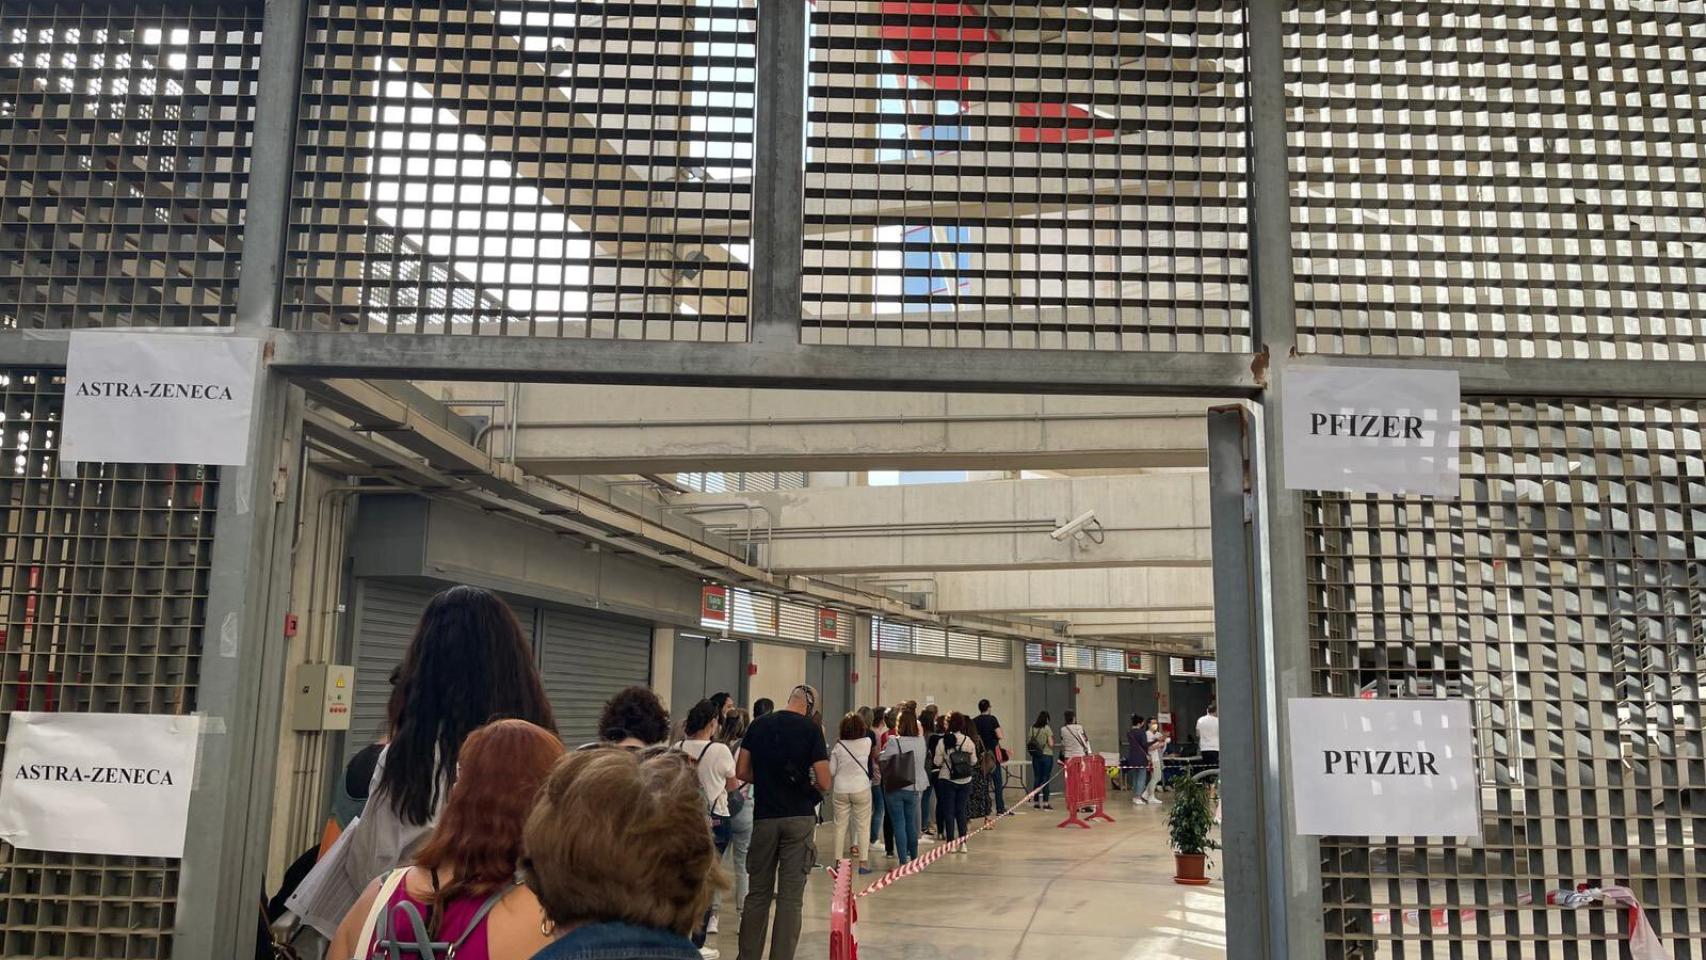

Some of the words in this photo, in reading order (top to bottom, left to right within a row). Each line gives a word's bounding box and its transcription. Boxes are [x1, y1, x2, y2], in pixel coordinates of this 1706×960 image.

[76, 382, 232, 400] ASTRA-ZENECA
[1309, 413, 1423, 438] PFIZER
[1323, 749, 1439, 775] PFIZER
[15, 764, 173, 786] ASTRA-ZENECA
